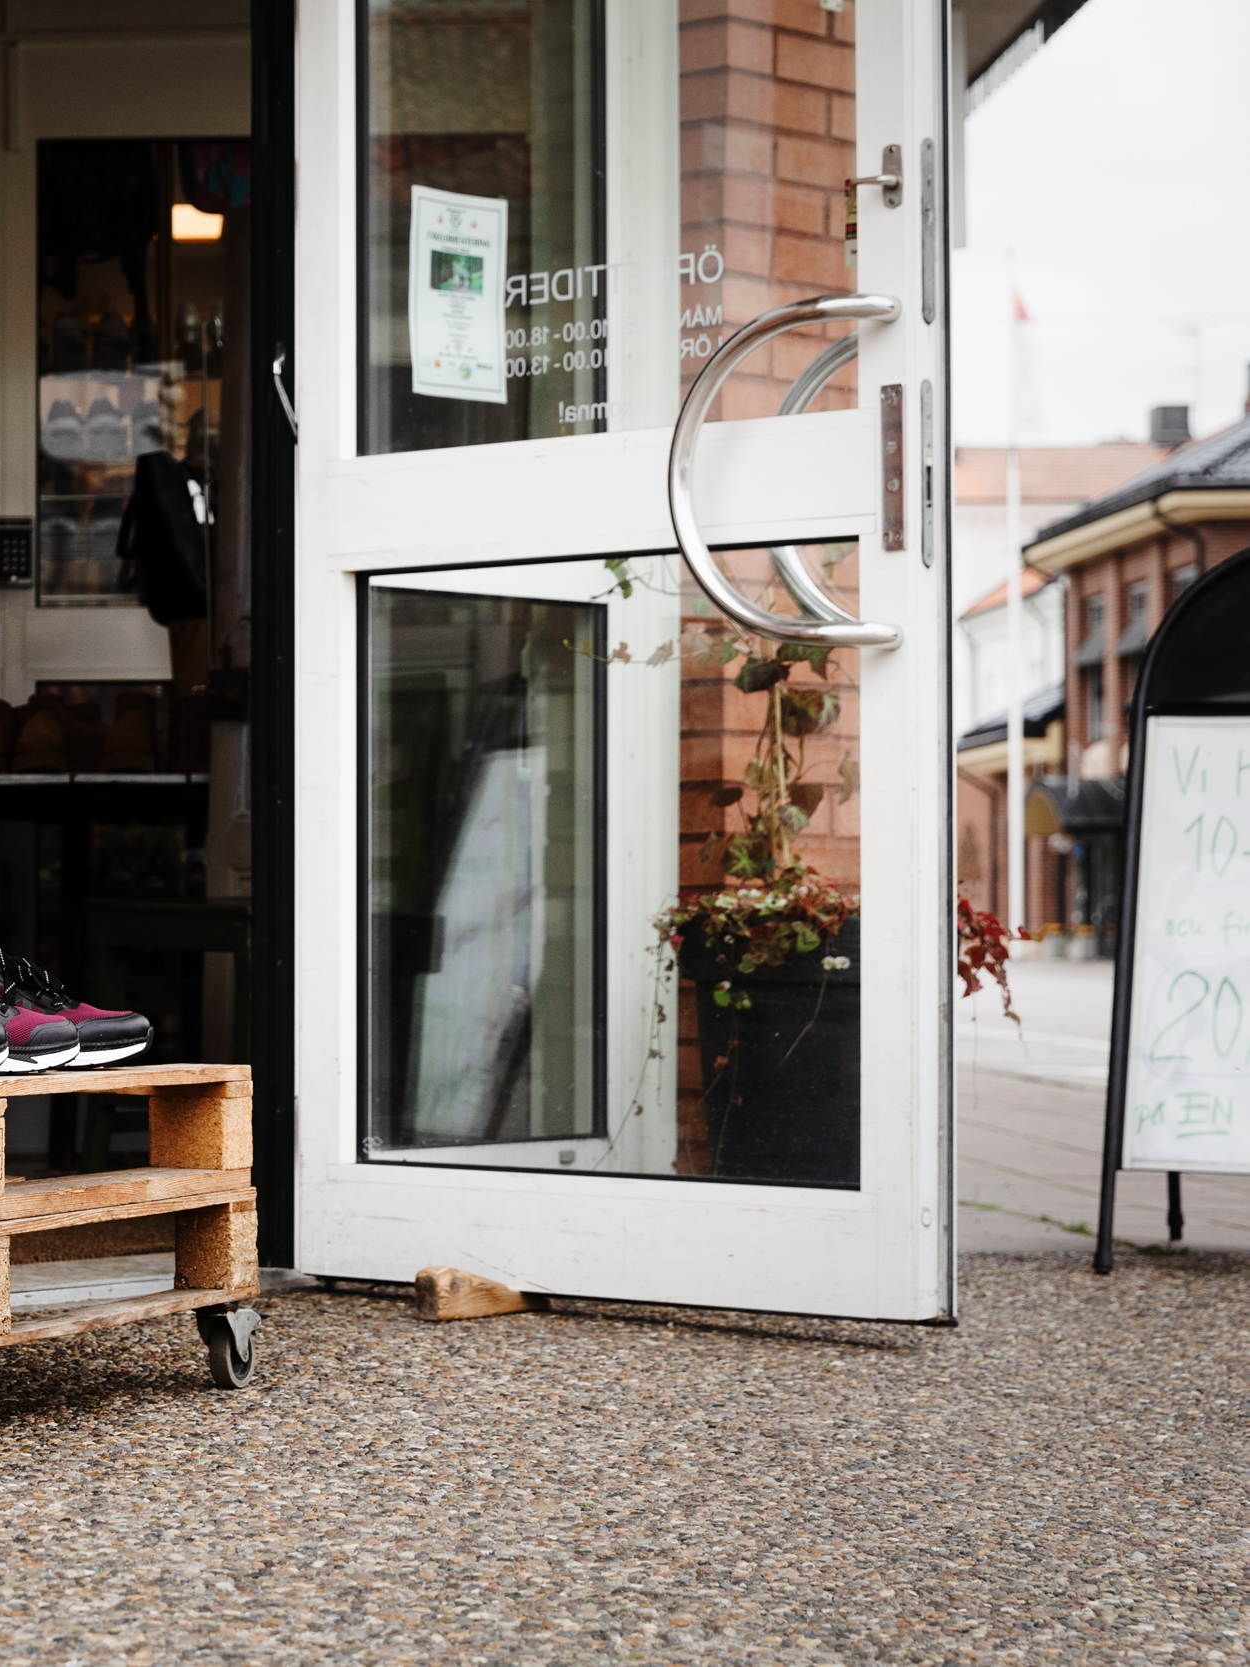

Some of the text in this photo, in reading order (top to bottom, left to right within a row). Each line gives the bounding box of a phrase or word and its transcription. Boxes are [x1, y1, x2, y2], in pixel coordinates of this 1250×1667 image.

[1172, 744, 1210, 796] Vi
[1148, 968, 1250, 1068] 20
[1174, 1091, 1235, 1126] EN
